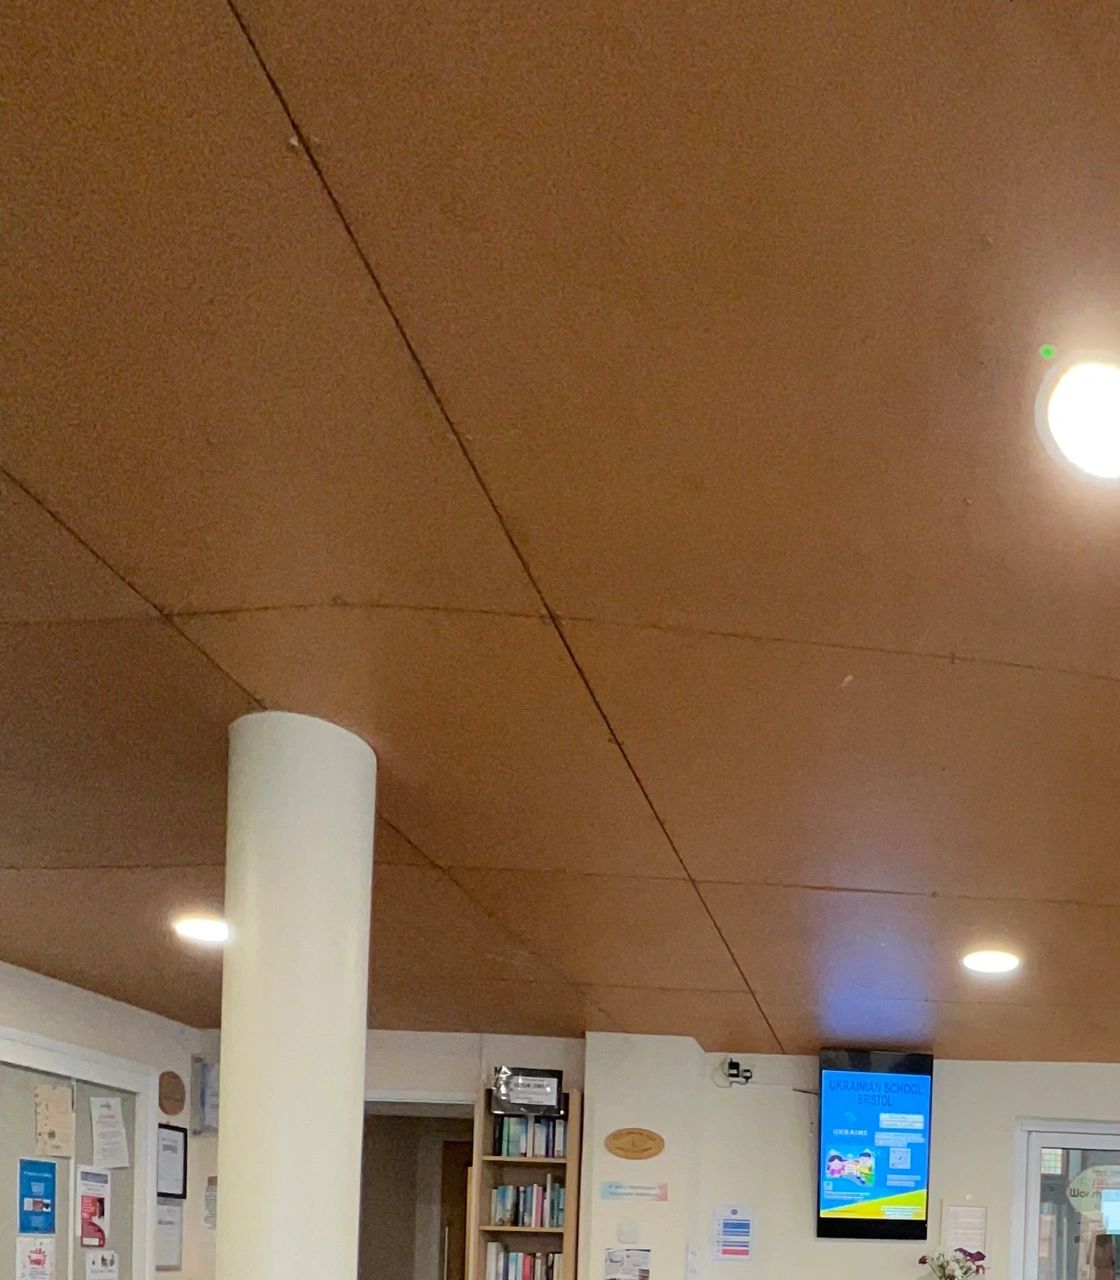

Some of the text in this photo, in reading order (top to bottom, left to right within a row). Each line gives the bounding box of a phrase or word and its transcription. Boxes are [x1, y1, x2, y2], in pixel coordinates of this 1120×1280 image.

[829, 1079, 924, 1095] UKRAINIAN SCHOOL
[857, 1094, 893, 1107] BRISTOL
